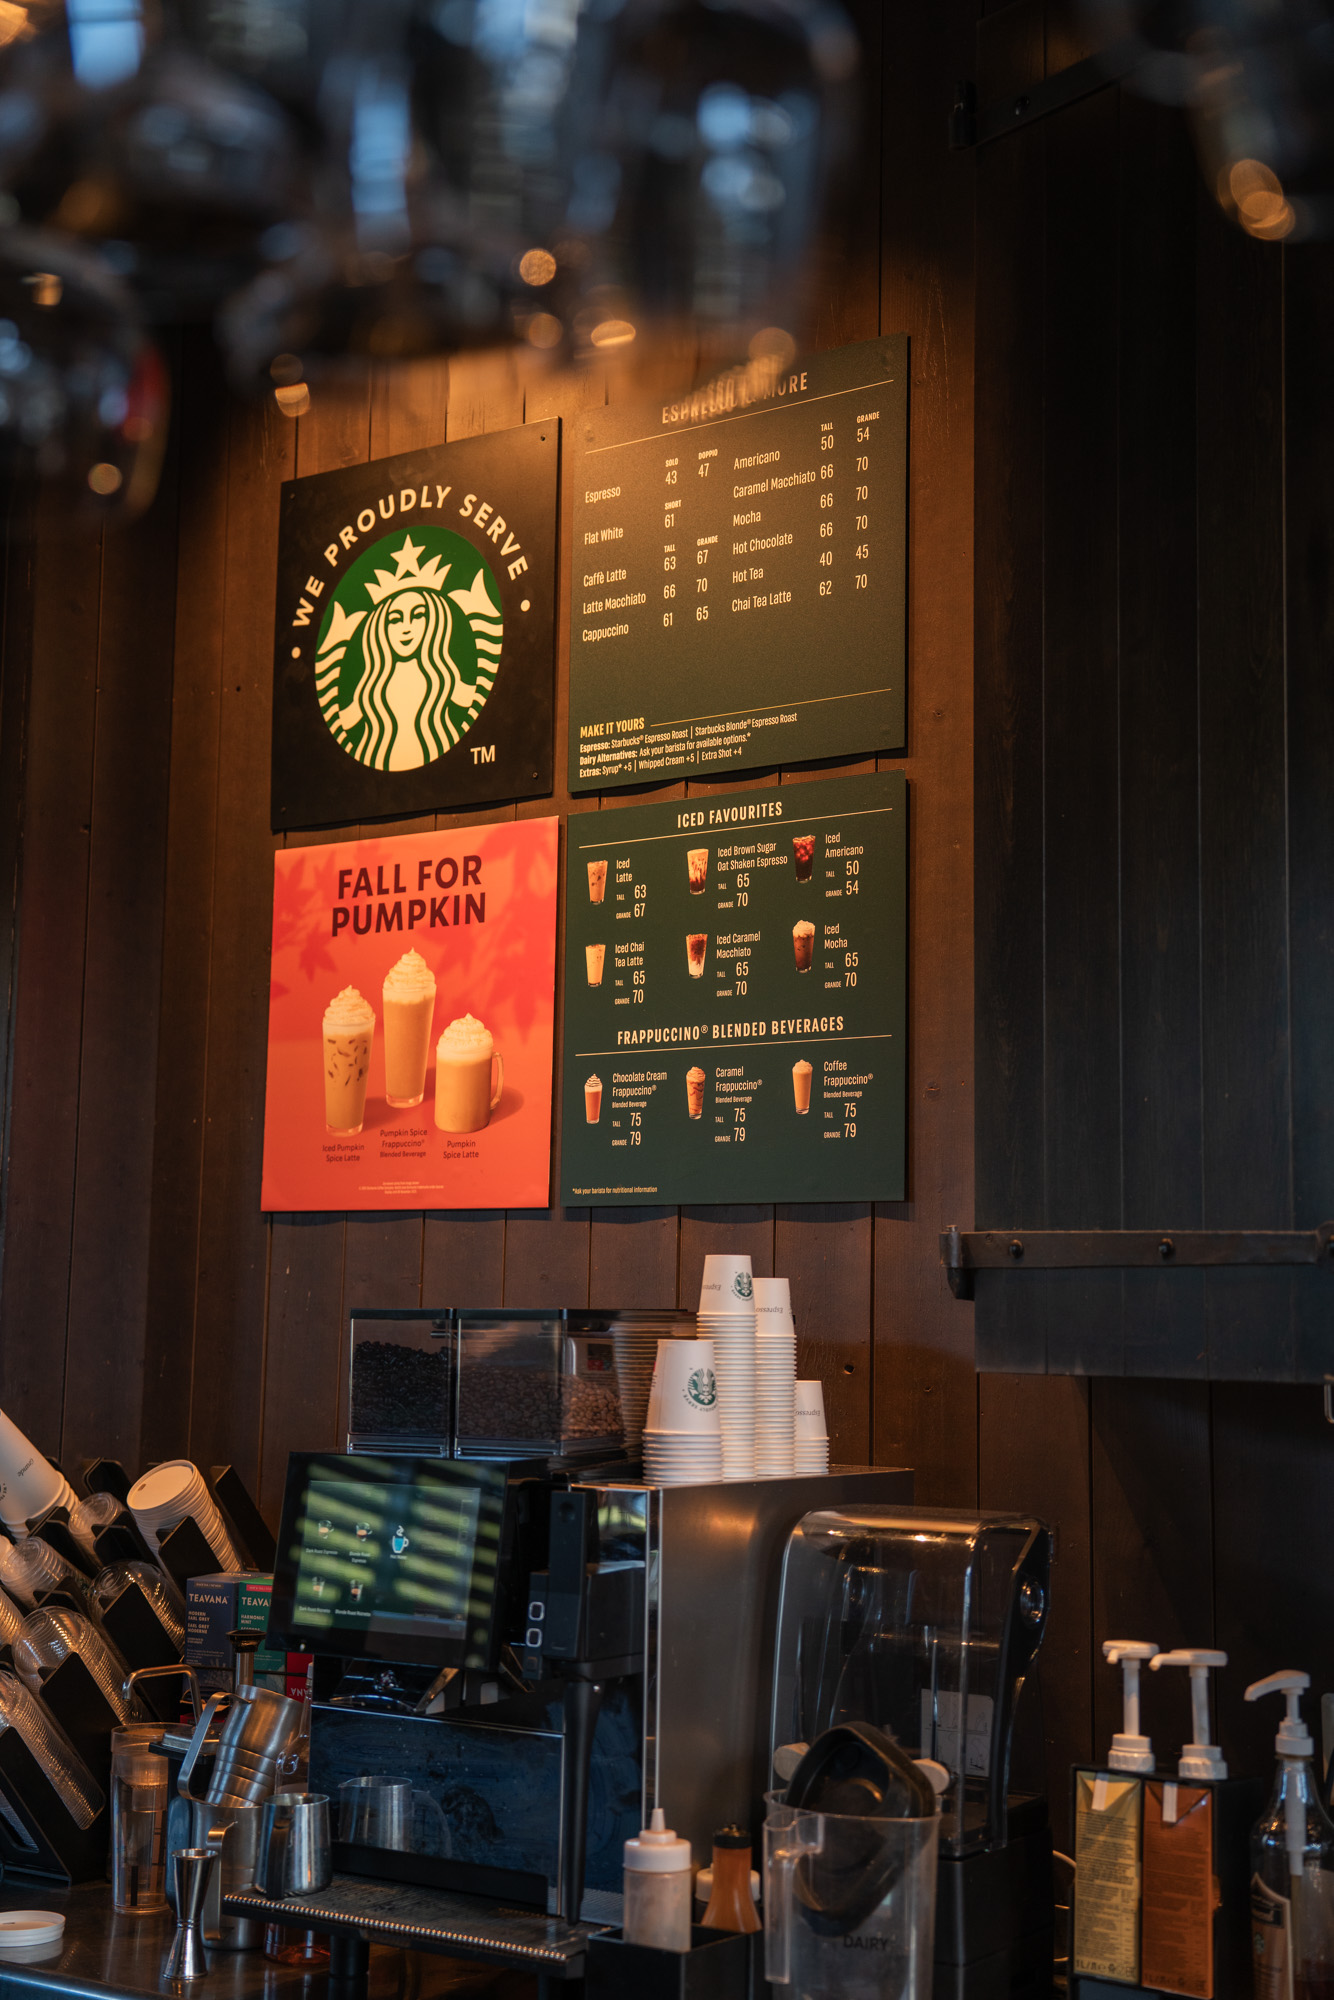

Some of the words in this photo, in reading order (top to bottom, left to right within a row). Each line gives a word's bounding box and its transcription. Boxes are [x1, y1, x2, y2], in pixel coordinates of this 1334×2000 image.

[820, 422, 834, 432] TALL
[856, 411, 880, 424] GRANDE
[820, 434, 834, 451] 50
[856, 427, 870, 443] 54
[665, 458, 679, 468] SOLO
[698, 448, 718, 460] DOPPIO
[733, 449, 781, 471] Americano
[665, 470, 678, 486] 43
[697, 463, 710, 478] 47
[732, 478, 769, 499] Caramel
[770, 468, 816, 491] Macchiato
[819, 463, 834, 480] 66
[856, 456, 869, 472] 70
[584, 485, 621, 504] Espresso
[664, 499, 682, 511] SHORT
[732, 510, 762, 527] Mocha
[819, 492, 834, 510] 66
[855, 485, 869, 501] 70
[664, 513, 675, 529] 61
[855, 514, 868, 531] 70
[584, 531, 599, 546] Flat
[601, 525, 624, 542] White
[664, 543, 676, 553] TALL
[696, 534, 719, 547] GRANDE
[732, 540, 748, 556] Hot
[749, 531, 794, 552] Chocolate
[819, 522, 833, 538] 66
[292, 575, 325, 627] WE
[323, 485, 452, 568] PROUDLY
[459, 493, 529, 581] SERVE
[663, 555, 677, 572] 63
[696, 549, 709, 565] 67
[731, 569, 747, 585] Hot
[748, 566, 764, 580] Tea
[819, 550, 833, 567] 40
[855, 543, 870, 560] 45
[583, 570, 605, 588] Caffè
[606, 567, 627, 584] Latte
[582, 599, 604, 615] Latte
[604, 591, 647, 610] Macchiato
[663, 583, 676, 600] 66
[696, 577, 708, 593] 70
[731, 597, 751, 613] Chai
[752, 593, 768, 608] Tea
[769, 589, 792, 606] Latte
[818, 580, 832, 596] 62
[855, 573, 868, 590] 70
[581, 623, 629, 643] Cappuccino
[662, 612, 674, 628] 61
[695, 605, 709, 622] 65
[579, 740, 610, 754] Espresso:
[644, 731, 671, 745] Espresso
[671, 729, 688, 739] Roast
[695, 723, 725, 737] Starbucks
[751, 715, 779, 729] Espresso
[779, 712, 798, 723] Roast
[580, 724, 604, 739] MAKE
[605, 721, 614, 735] IT
[615, 717, 645, 734] YOURS
[470, 744, 496, 765] TM
[579, 754, 596, 767] Dairy
[596, 749, 638, 763] Alternatives:
[639, 747, 650, 757] Ask
[650, 745, 664, 757] your
[664, 741, 685, 753] barista
[686, 740, 695, 750] for
[695, 735, 722, 749] available
[579, 767, 602, 778] Extras:
[638, 754, 664, 770] Whipped
[665, 753, 685, 765] Cream
[701, 749, 717, 761] Extra
[718, 747, 732, 758] Shot
[677, 811, 705, 829] ICED
[709, 801, 784, 825] FAVOURITES
[825, 832, 841, 845] Iced
[717, 846, 731, 858] Iced
[733, 844, 755, 856] Brown
[756, 841, 777, 855] Sugar
[825, 844, 864, 859] Americano
[616, 858, 630, 870] Iced
[717, 860, 729, 872] Oat
[730, 857, 755, 871] Shaken
[756, 854, 788, 869] Espresso
[845, 859, 859, 876] 50
[337, 862, 407, 900] FALL
[417, 854, 482, 892] FOR
[616, 870, 633, 883] Latte
[736, 872, 750, 888] 65
[633, 884, 647, 900] 63
[845, 879, 859, 896] 54
[736, 892, 749, 908] 70
[332, 892, 487, 937] PUMPKIN
[633, 902, 646, 918] 67
[716, 933, 731, 945] Iced
[732, 930, 761, 944] Caramel
[824, 923, 840, 936] Iced
[615, 942, 629, 954] Iced
[630, 940, 645, 953] Chai
[824, 937, 848, 950] Mocha
[614, 956, 626, 968] Tea
[626, 954, 644, 967] Latte
[716, 946, 752, 959] Macchiato
[845, 952, 859, 968] 65
[735, 961, 749, 977] 65
[633, 970, 646, 986] 65
[844, 971, 857, 988] 70
[735, 980, 748, 996] 70
[632, 989, 645, 1005] 70
[712, 1021, 767, 1040] BLENDED
[771, 1016, 845, 1036] BEVERAGES
[715, 1065, 744, 1079] Caramel
[823, 1060, 848, 1073] Coffee
[612, 1071, 645, 1084] Chocolate
[646, 1070, 668, 1082] Cream
[734, 1107, 746, 1123] 75
[844, 1102, 857, 1119] 75
[630, 1112, 642, 1128] 75
[380, 1129, 408, 1138] Pumpkin
[408, 1128, 428, 1138] Spice
[629, 1131, 641, 1147] 79
[733, 1127, 746, 1143] 79
[844, 1122, 857, 1139] 79
[322, 1144, 335, 1152] Iced
[336, 1143, 365, 1153] Pumpkin
[446, 1139, 476, 1149] Pumpkin
[326, 1154, 343, 1163] Spice
[344, 1153, 361, 1162] Latte
[442, 1151, 461, 1160] Spice
[461, 1150, 479, 1158] Latte
[843, 1934, 889, 1951] DAIRY
